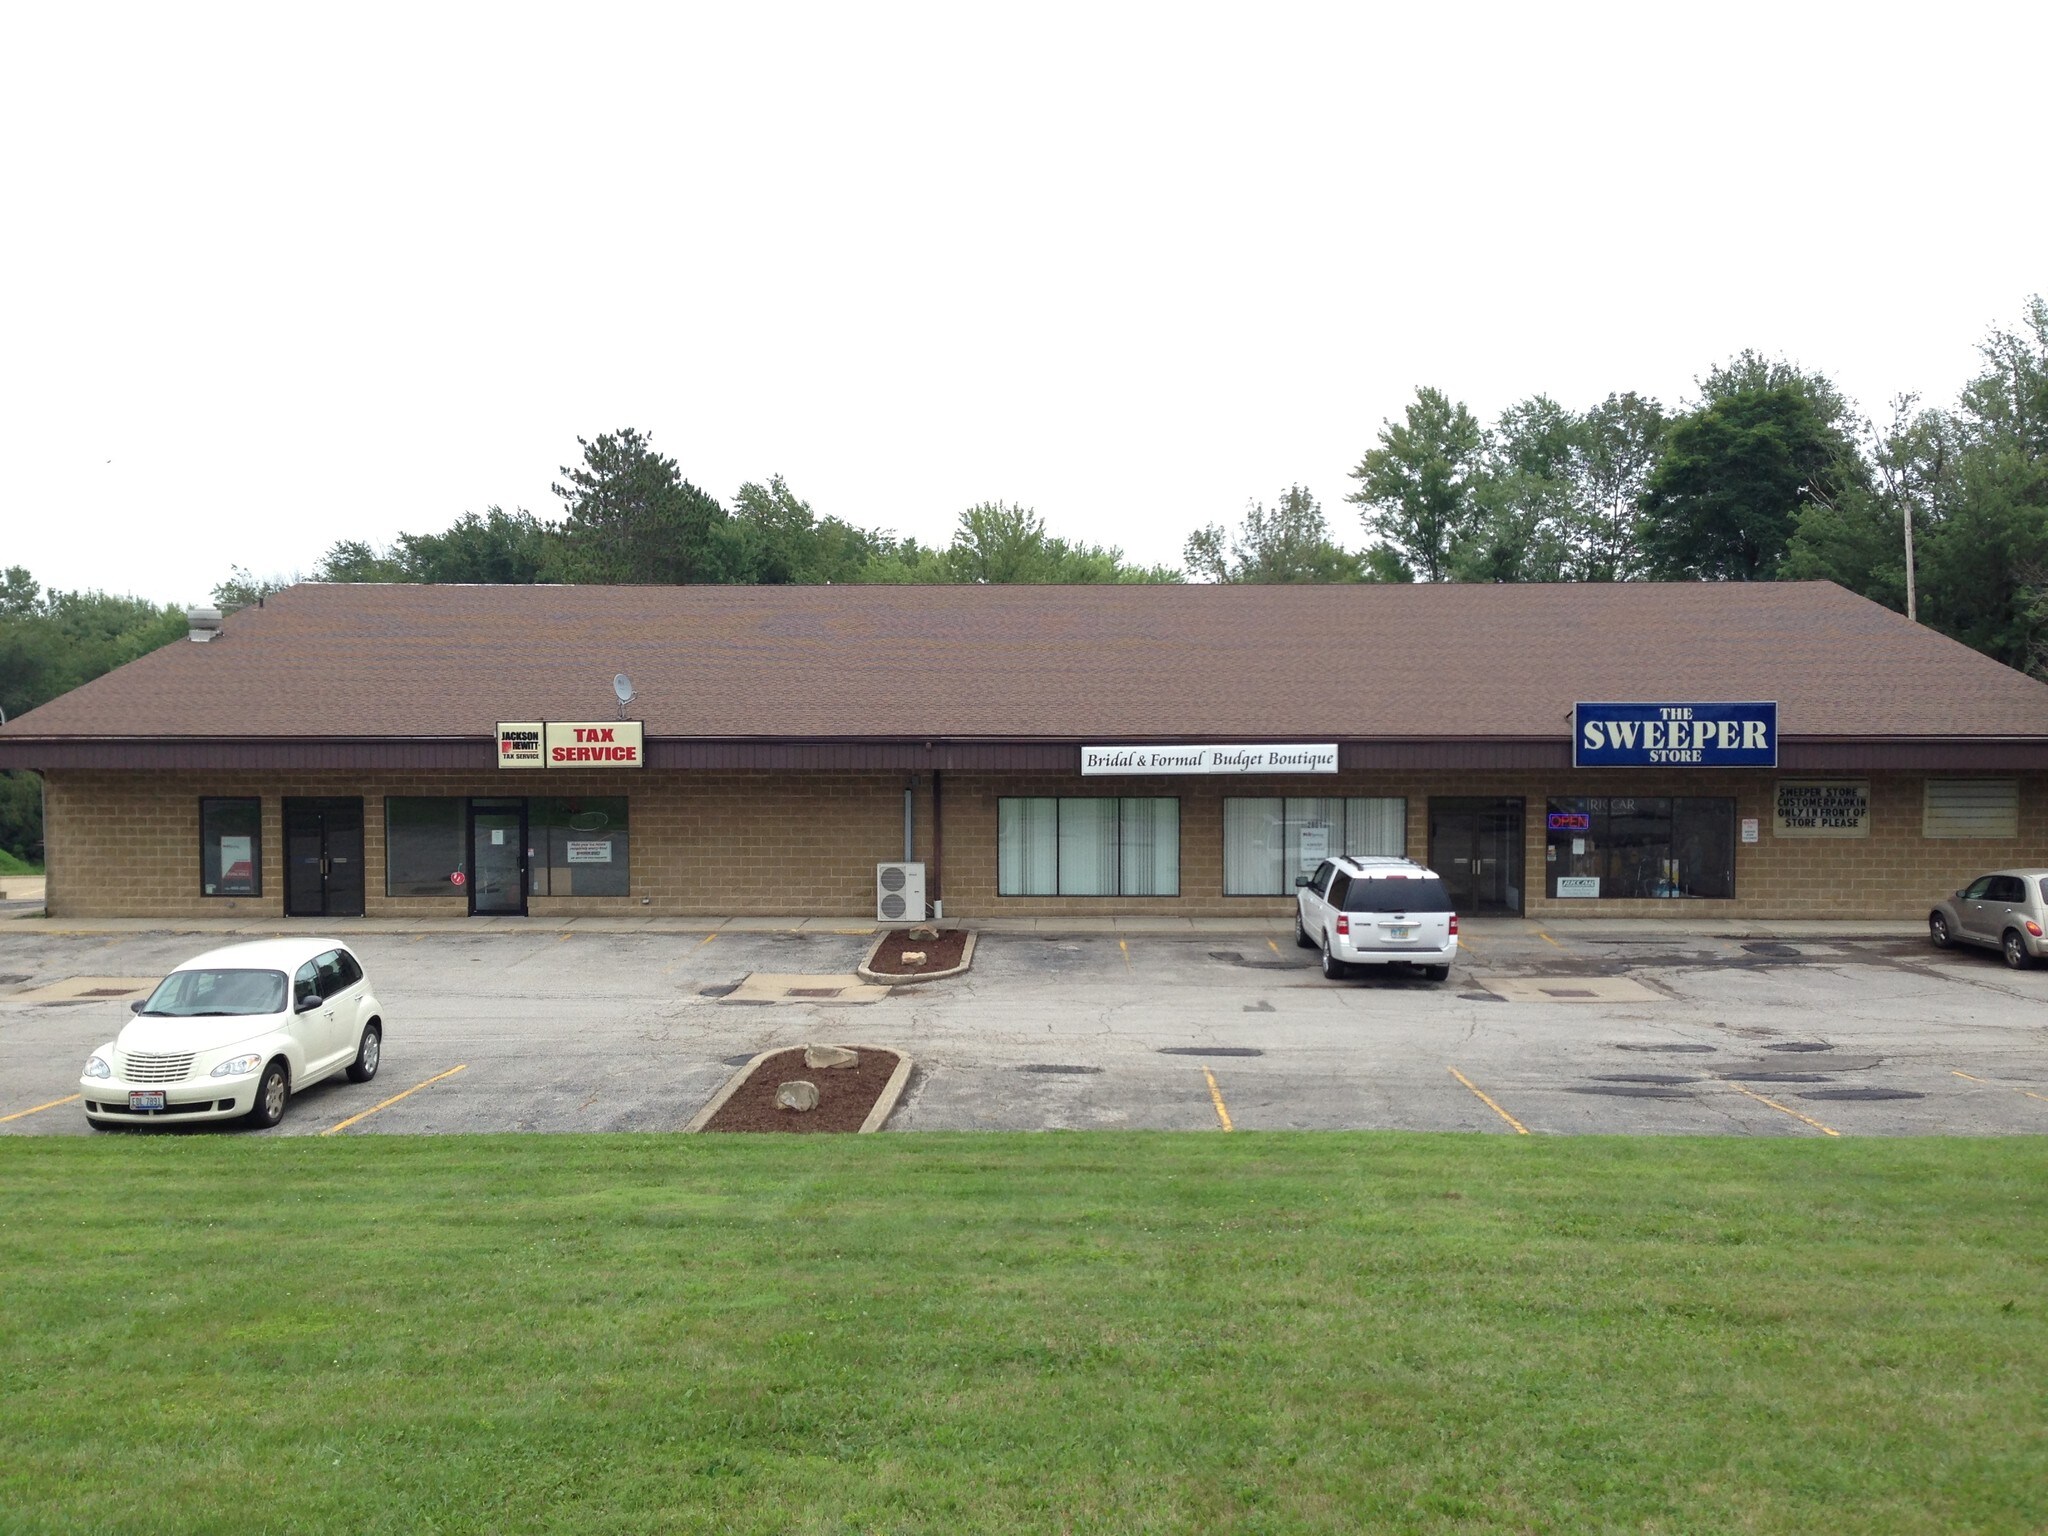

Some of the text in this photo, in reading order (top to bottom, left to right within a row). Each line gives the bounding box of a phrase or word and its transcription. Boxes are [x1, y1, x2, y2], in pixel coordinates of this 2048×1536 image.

[1660, 707, 1693, 720] THE
[501, 731, 538, 741] JACKSON
[573, 728, 614, 743] TAX
[1583, 720, 1768, 750] SWEEPER
[512, 741, 539, 750] HEWITT
[552, 746, 637, 761] SERVICE
[1649, 750, 1702, 762] STORE
[1087, 750, 1334, 771] Bridal & Formal Budget Boutique
[1779, 787, 1858, 797] SWEEPER STORE
[1777, 808, 1866, 817] ONLY IN FRONT OF
[1551, 816, 1587, 827] OPEN
[1785, 818, 1859, 828] STORE PLEASE
